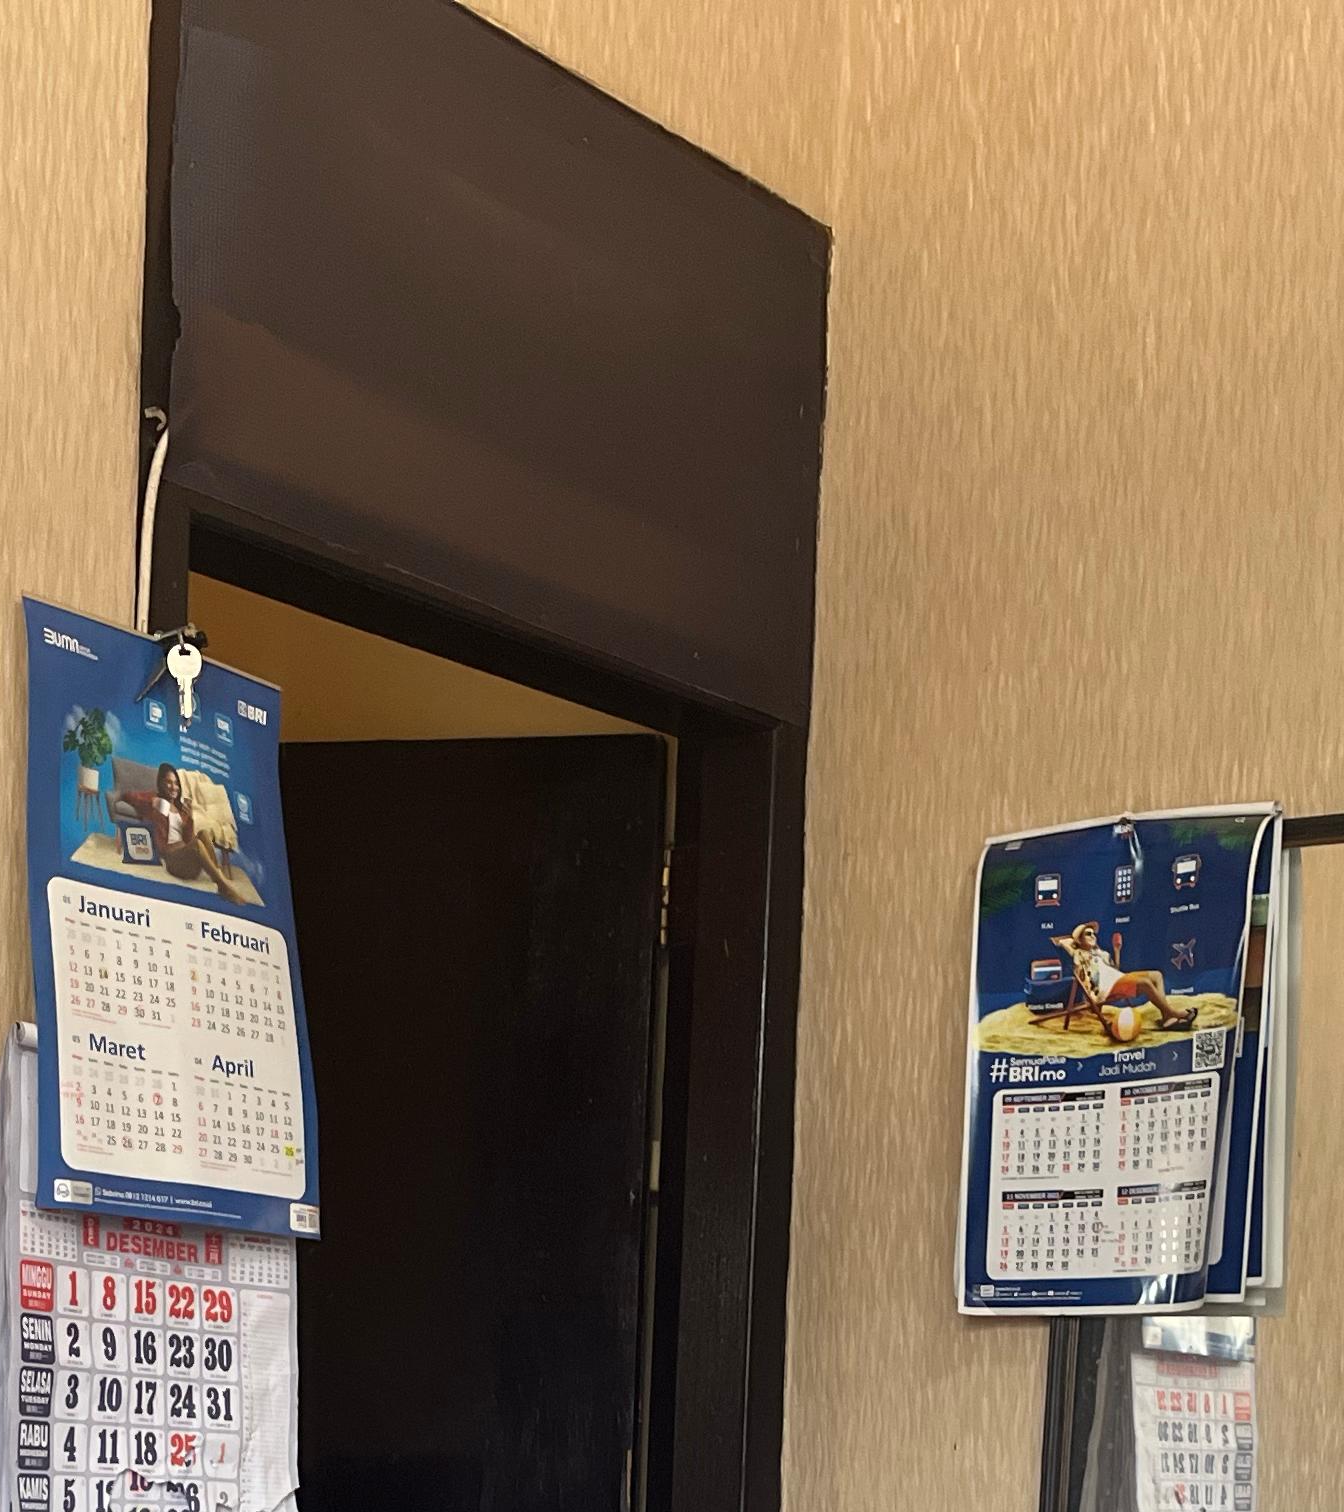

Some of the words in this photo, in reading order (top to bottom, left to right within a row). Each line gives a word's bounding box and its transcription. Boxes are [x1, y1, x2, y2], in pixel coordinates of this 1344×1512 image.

[79, 896, 150, 927] Januari
[201, 921, 269, 954] Februari
[69, 961, 77, 972] 12
[84, 966, 92, 976] 13
[99, 969, 108, 979] 14
[116, 973, 125, 982] 15
[133, 976, 142, 985] 16
[149, 979, 158, 988] 17
[166, 982, 174, 991] 18
[148, 963, 157, 972] 10
[164, 966, 173, 976] 11
[85, 982, 94, 992] 20
[100, 986, 109, 996] 21
[116, 989, 126, 999] 22
[133, 992, 143, 1002] 23
[150, 995, 159, 1004] 24
[166, 998, 176, 1007] 25
[86, 999, 95, 1008] 27
[102, 1002, 110, 1012] 28
[118, 1005, 127, 1015] 29
[135, 1007, 145, 1018] 30
[152, 1010, 161, 1020] 31
[89, 1033, 146, 1060] Maret
[1113, 1048, 1145, 1063] Travel
[212, 1055, 254, 1077] April
[1099, 1065, 1120, 1077] Jadi
[1122, 1062, 1156, 1074] Mudah
[91, 1101, 99, 1110] 10
[106, 1103, 115, 1113] 11
[122, 1106, 130, 1116] 12
[137, 1109, 146, 1118] 13
[154, 1111, 164, 1120] 14
[172, 1113, 181, 1122] 15
[91, 1117, 100, 1126] 17
[107, 1120, 115, 1129] 18
[122, 1123, 131, 1132] 19
[138, 1125, 148, 1134] 20
[155, 1127, 164, 1136] 21
[172, 1129, 181, 1138] 22
[107, 1136, 116, 1146] 25
[122, 1138, 132, 1148] 26
[139, 1140, 148, 1149] 27
[156, 1142, 165, 1152] 28
[173, 1145, 182, 1154] 29
[132, 1219, 174, 1236] 2024
[106, 1232, 198, 1263] DESEMBER
[23, 1289, 51, 1299] SUNDAY
[69, 1271, 78, 1306] 1
[103, 1276, 116, 1310] 8
[134, 1279, 156, 1315] 15
[169, 1284, 195, 1319] 22
[203, 1289, 233, 1323] 29
[22, 1317, 52, 1341] SENIN
[24, 1342, 52, 1351] MONDAY
[67, 1322, 80, 1358] 2
[102, 1327, 117, 1361] 9
[134, 1330, 156, 1365] 16
[169, 1334, 195, 1368] 23
[204, 1338, 232, 1372] 30
[21, 1370, 50, 1394] SELASA
[66, 1374, 79, 1409] 3
[98, 1377, 122, 1411] 10
[134, 1381, 156, 1415] 17
[170, 1384, 196, 1418] 24
[207, 1387, 233, 1421] 31
[20, 1423, 48, 1448] RABU
[64, 1427, 76, 1462] 4
[98, 1429, 119, 1464] 11
[134, 1431, 157, 1466] 18
[170, 1433, 196, 1467] 25
[19, 1477, 49, 1501] KAMIS
